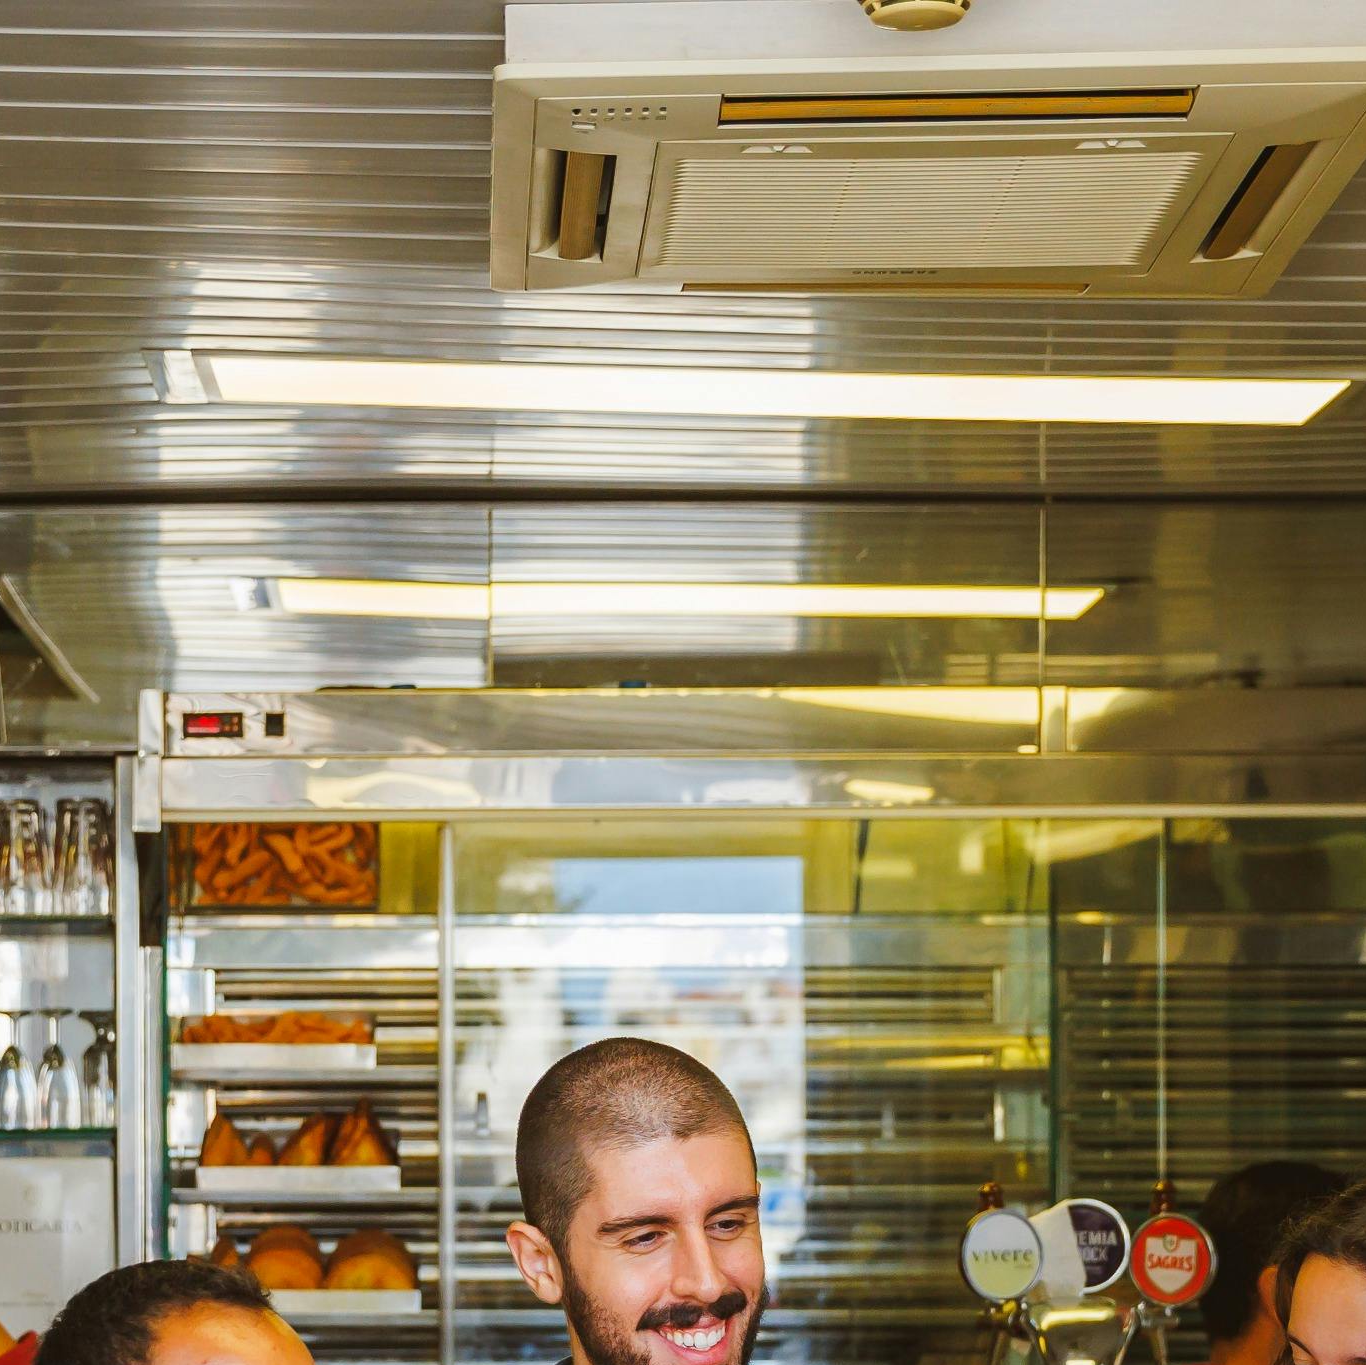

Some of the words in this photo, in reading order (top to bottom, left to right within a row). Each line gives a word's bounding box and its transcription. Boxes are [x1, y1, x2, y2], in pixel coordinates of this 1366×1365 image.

[1075, 1231, 1117, 1246] EMIA
[1080, 1246, 1108, 1261] OCK
[1147, 1252, 1193, 1271] SAGRES
